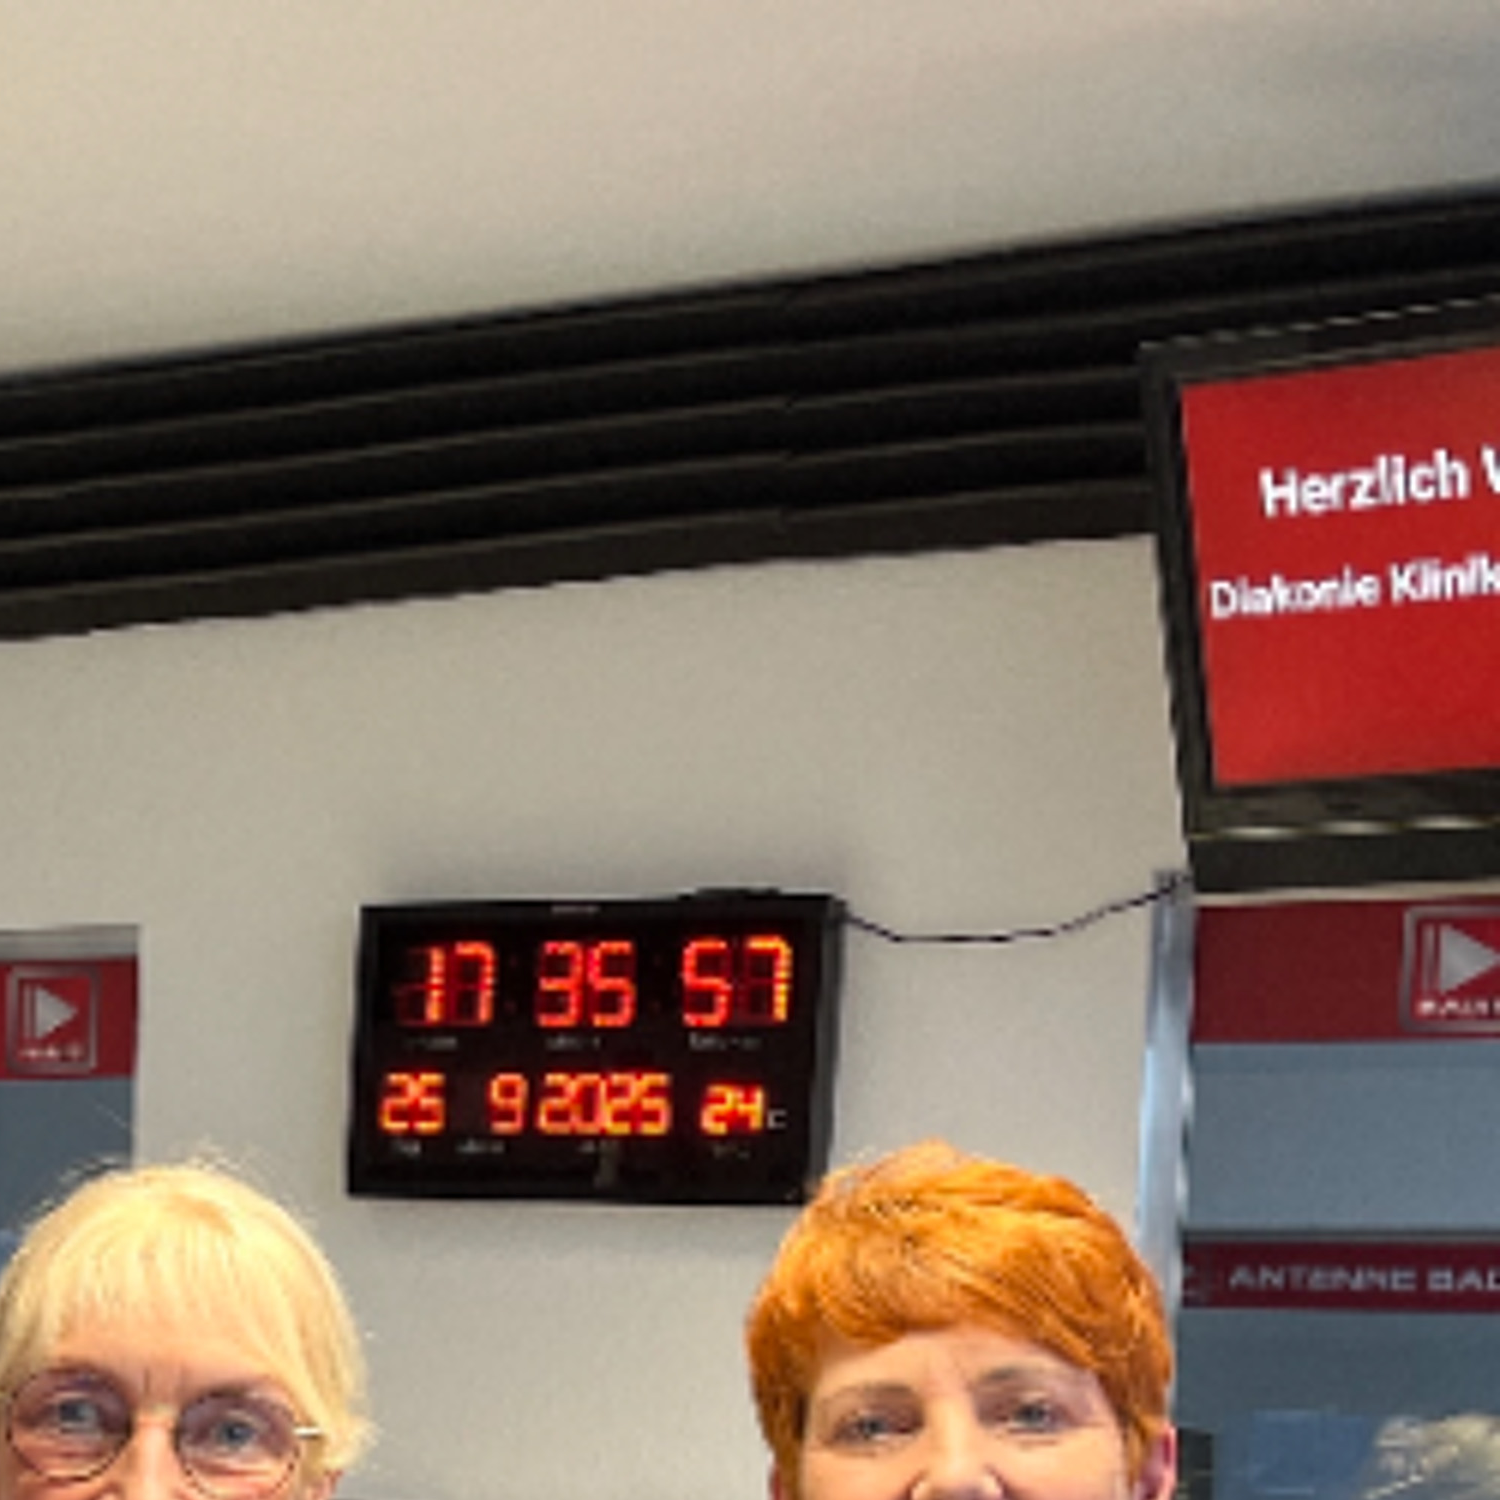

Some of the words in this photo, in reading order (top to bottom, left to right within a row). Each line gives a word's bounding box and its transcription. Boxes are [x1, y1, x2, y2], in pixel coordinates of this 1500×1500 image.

[1260, 449, 1471, 518] Herzlich
[1210, 566, 1380, 619] Diakonie
[425, 942, 495, 1023] 17
[537, 940, 636, 1027] 35
[683, 934, 792, 1027] 57
[380, 1072, 446, 1135] 25
[489, 1072, 528, 1135] 9
[536, 1072, 670, 1135] 2025
[700, 1084, 764, 1135] 24
[1227, 1264, 1418, 1292] ANTENNE
